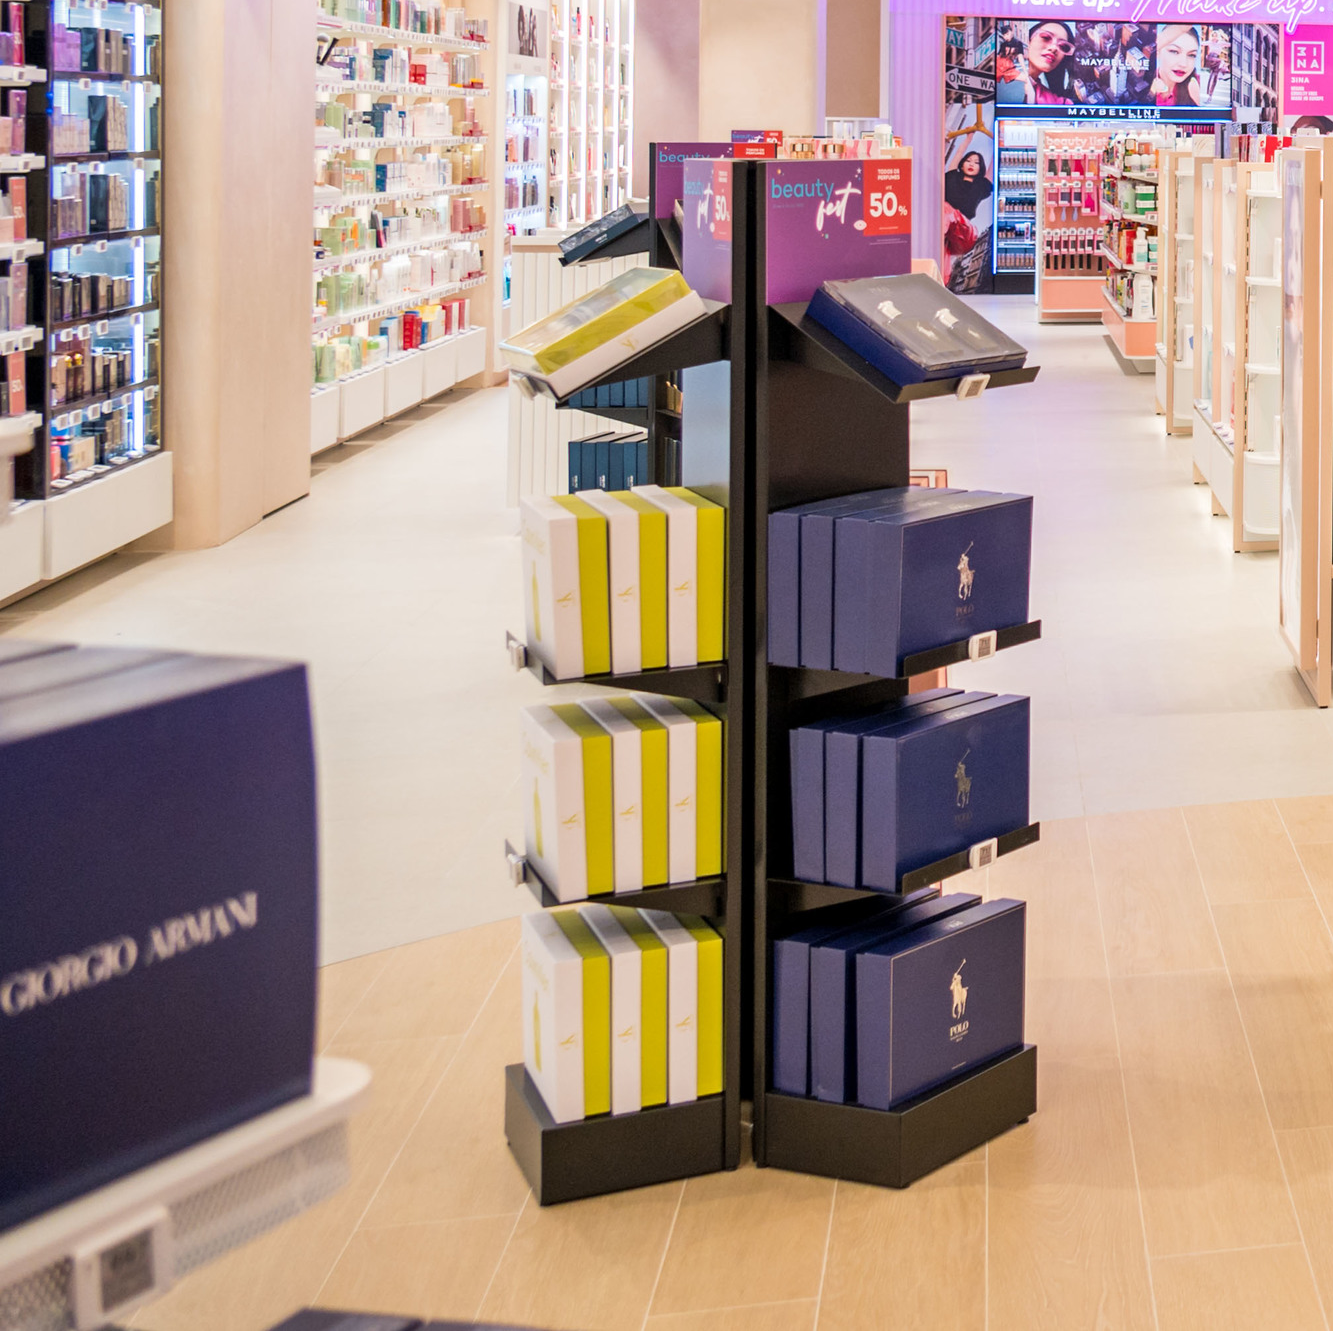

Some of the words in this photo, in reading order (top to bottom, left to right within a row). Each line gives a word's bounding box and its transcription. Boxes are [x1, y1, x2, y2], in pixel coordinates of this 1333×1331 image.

[1080, 58, 1150, 67] MAYBELLINE
[950, 73, 970, 85] ONE
[1068, 108, 1160, 116] MAYBELLINE
[1045, 136, 1087, 149] beauty
[771, 179, 834, 201] beauty
[815, 182, 861, 231] fest
[869, 192, 908, 218] 50%
[0, 934, 138, 1017] GIORGIO
[950, 1021, 969, 1037] POLO
